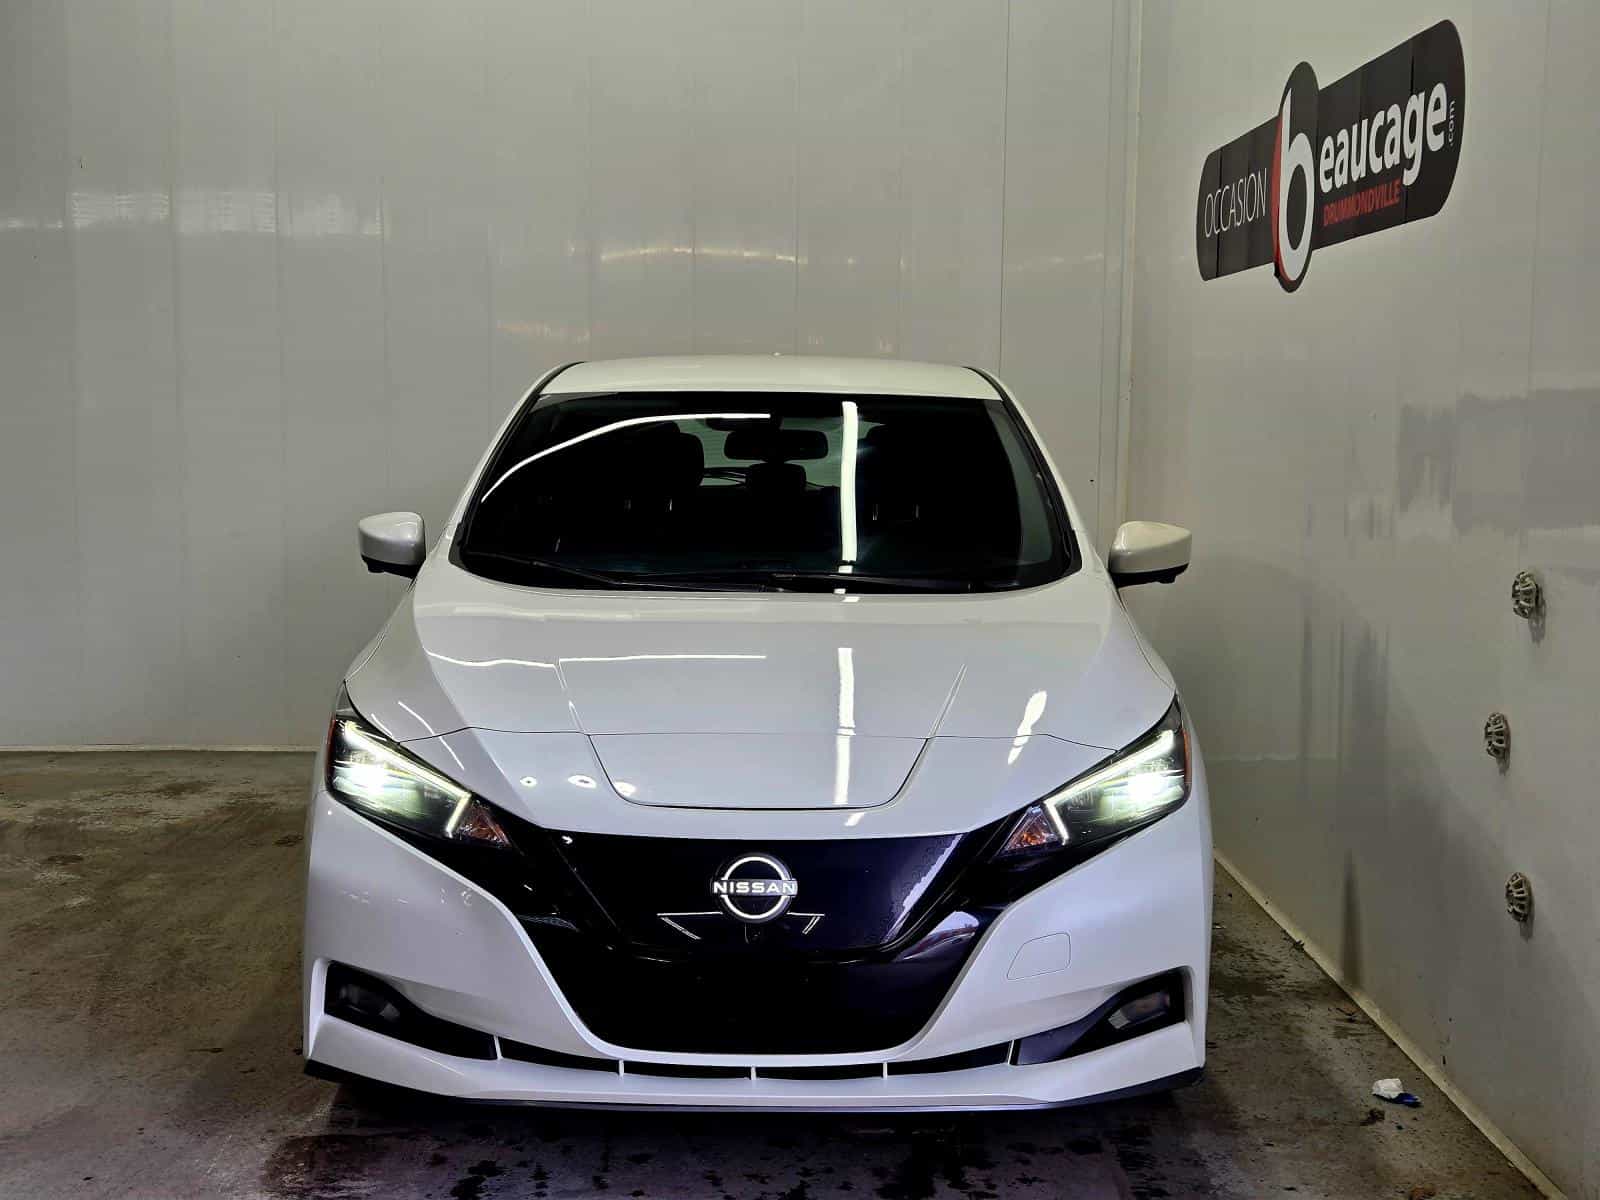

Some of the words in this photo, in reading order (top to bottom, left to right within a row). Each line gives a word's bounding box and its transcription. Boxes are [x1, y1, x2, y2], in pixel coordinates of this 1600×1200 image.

[1205, 168, 1267, 237] OCCASION
[1323, 179, 1401, 226] DRUMMONDVILLE
[713, 881, 795, 894] NISSAN
